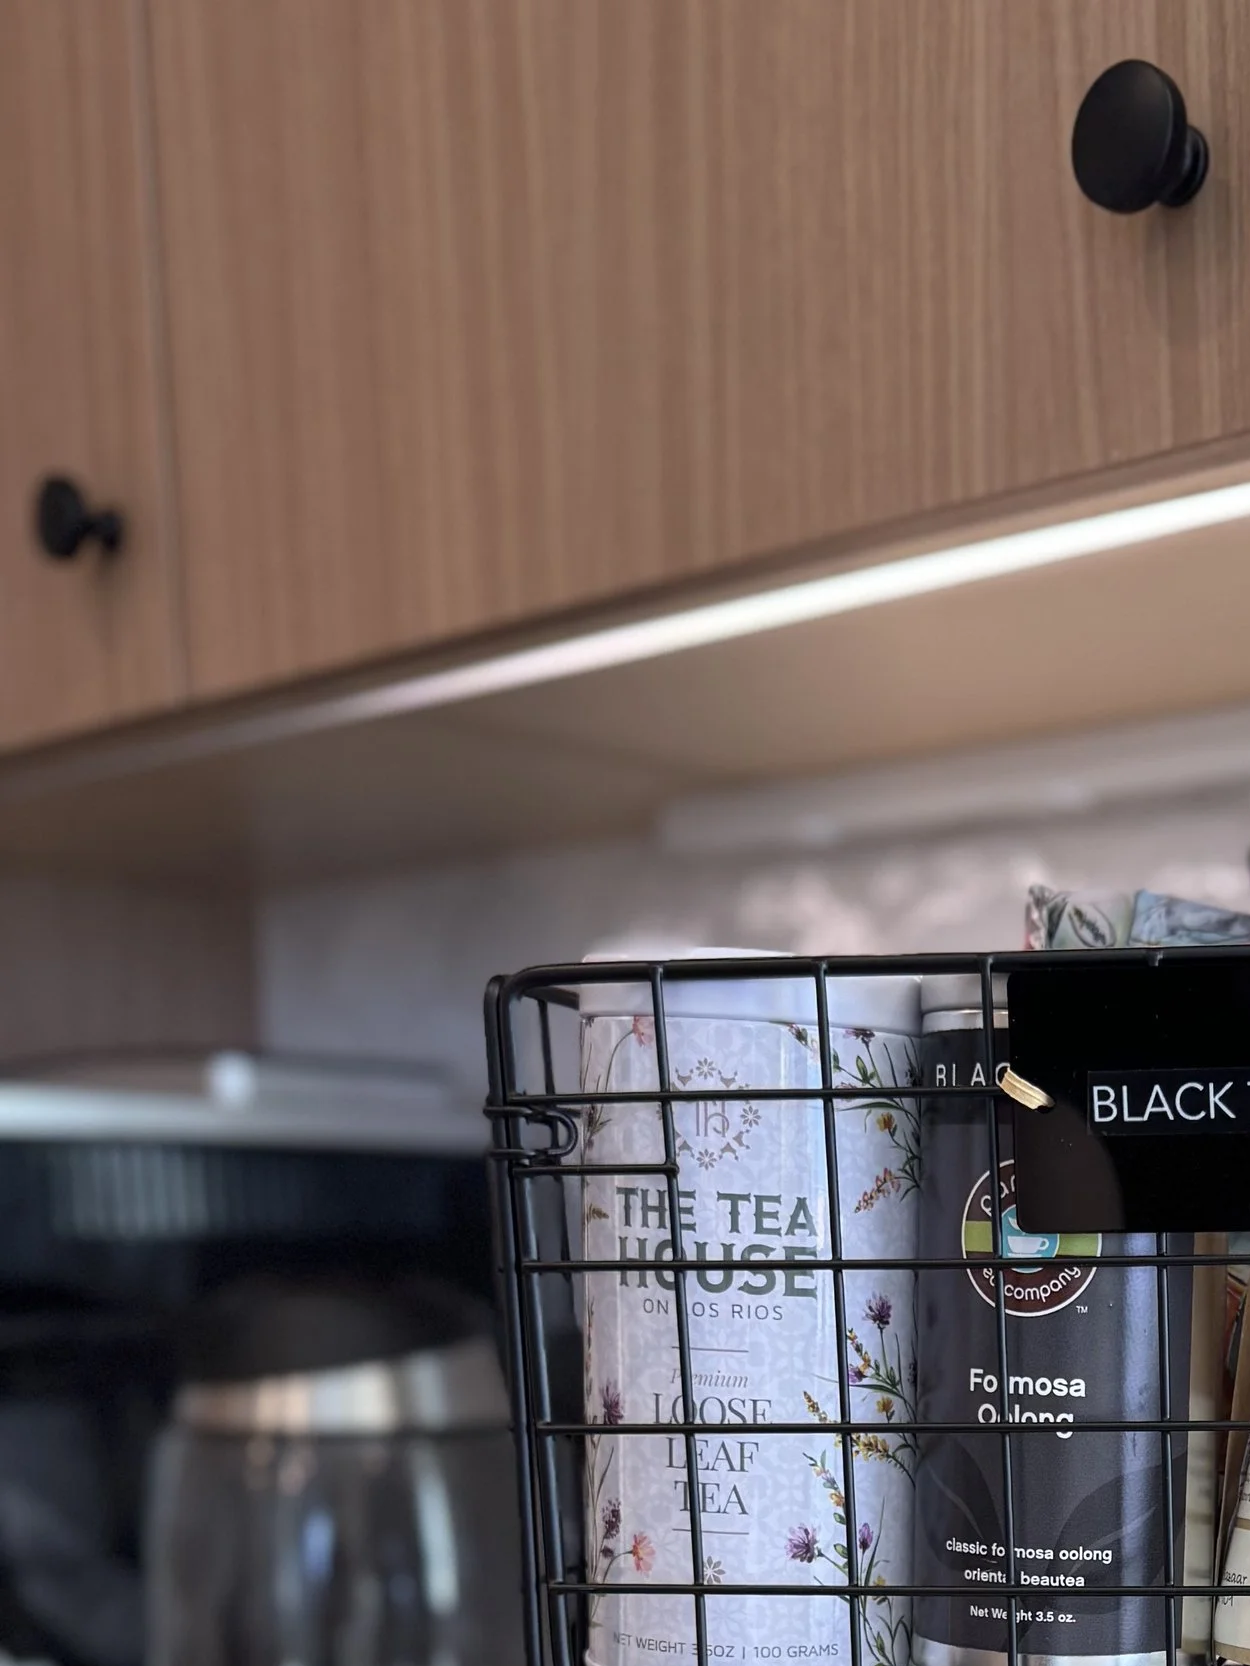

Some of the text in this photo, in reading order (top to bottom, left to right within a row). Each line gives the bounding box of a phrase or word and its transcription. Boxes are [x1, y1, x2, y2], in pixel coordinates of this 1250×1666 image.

[1092, 1081, 1236, 1122] BLACK
[616, 1186, 819, 1237] THE TEA
[1004, 1266, 1081, 1302] company
[643, 1298, 783, 1321] ON OS RIOS
[969, 1367, 1086, 1397] Fomosa
[674, 1480, 749, 1515] TEA
[945, 1537, 1113, 1564] classic fomosa oolong
[1020, 1571, 1085, 1587] beautea
[970, 1605, 1076, 1623] Net Weght 3.5 oz.
[613, 1632, 633, 1646] NET
[636, 1638, 687, 1655] WEIGHT
[754, 1646, 782, 1658] 100
[786, 1643, 839, 1658] GRAMS
